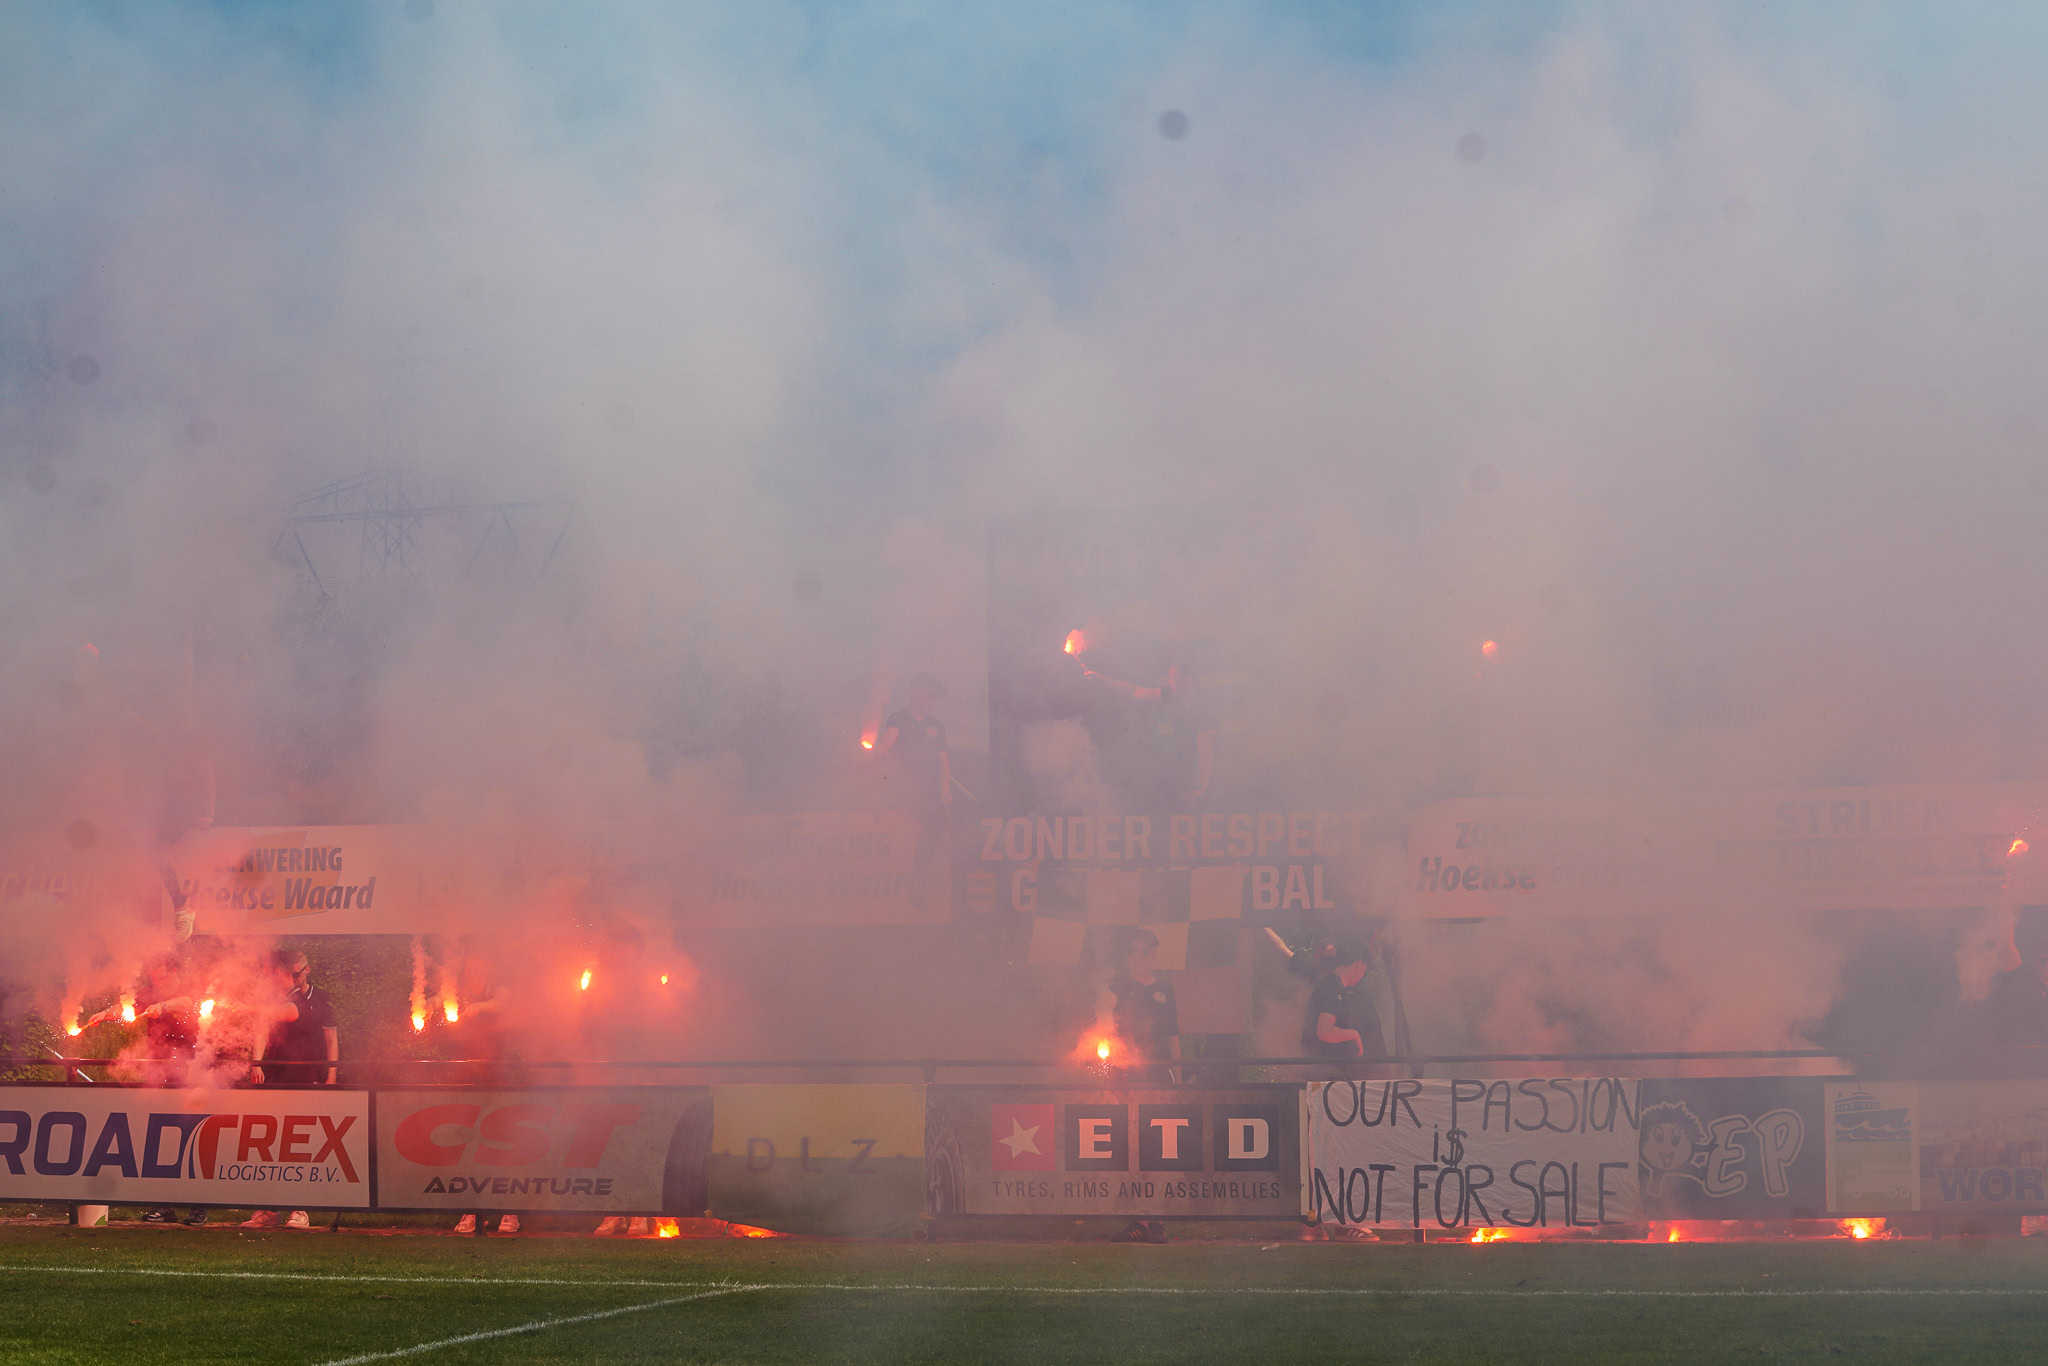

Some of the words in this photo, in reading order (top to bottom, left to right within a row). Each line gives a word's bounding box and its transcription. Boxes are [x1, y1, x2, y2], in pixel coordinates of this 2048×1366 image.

[979, 816, 1151, 861] ZONDER
[284, 876, 376, 910] Waard
[1322, 1080, 1422, 1128] OUR
[1451, 1078, 1641, 1133] PASSION
[394, 1103, 642, 1169] CST
[218, 1164, 303, 1183] LOGISTICS
[309, 1167, 341, 1183] B.V.
[424, 1176, 614, 1196] ADVENTURE
[992, 1180, 1054, 1200] TYRES,
[1064, 1181, 1109, 1198] RIMS
[1119, 1181, 1155, 1198] AND
[1164, 1181, 1281, 1199] ASSEMBLIES
[1313, 1163, 1396, 1227] NOT
[1413, 1164, 1494, 1229] FOR
[1502, 1159, 1629, 1229] SALE
